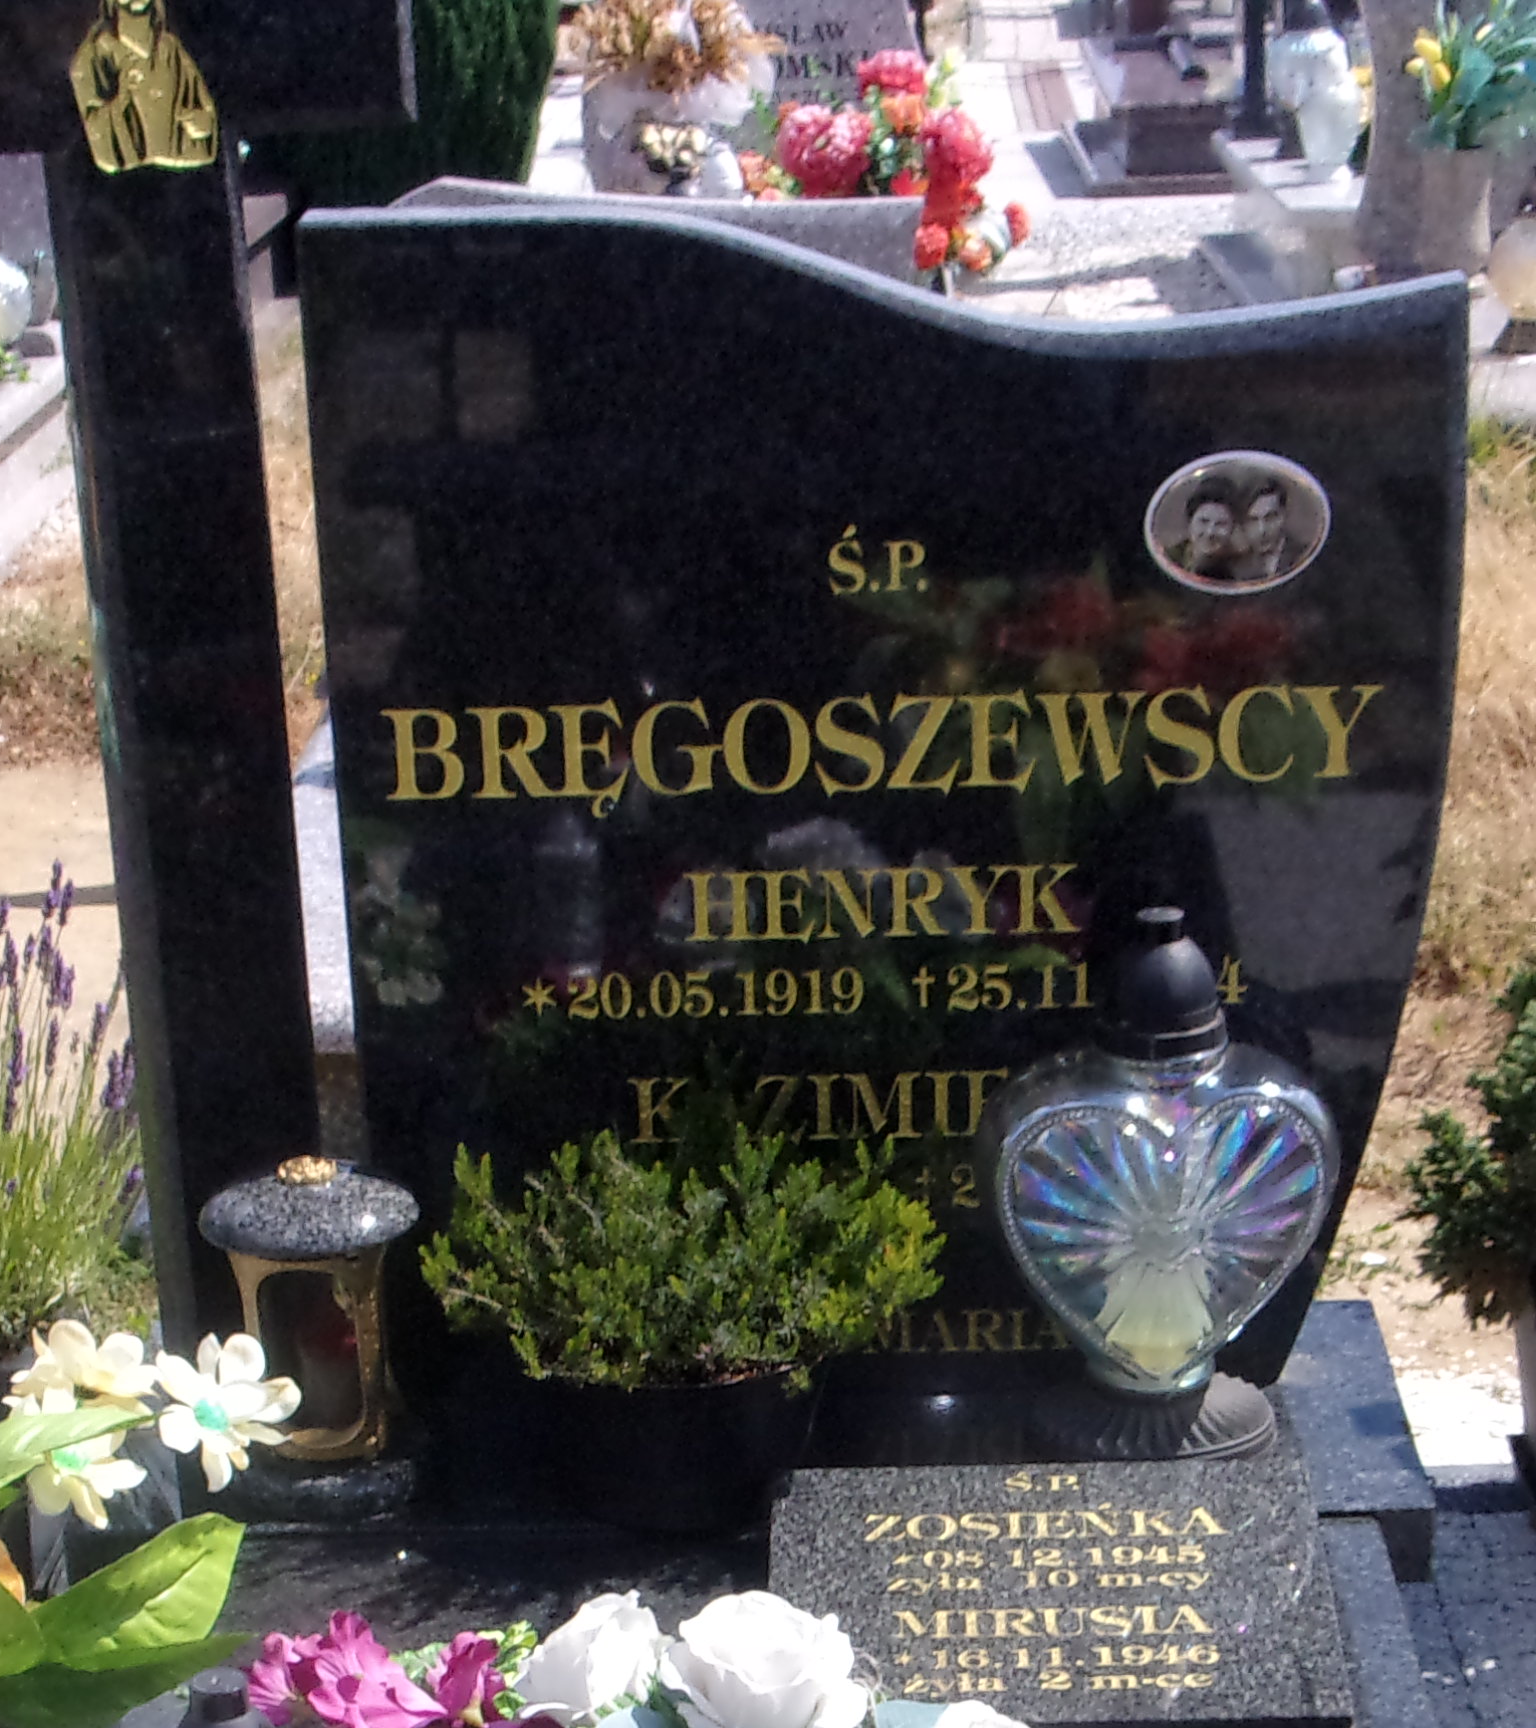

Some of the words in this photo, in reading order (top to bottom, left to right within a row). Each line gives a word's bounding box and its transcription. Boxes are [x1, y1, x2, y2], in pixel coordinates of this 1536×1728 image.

[828, 523, 928, 596] Ś.P.
[380, 684, 1384, 820] BRĘGOSZEWSCY
[684, 863, 1082, 943] HENRYK
[864, 1502, 1230, 1543] ZOSIEŃKA
[1023, 1569, 1079, 1589] 10
[892, 1604, 1214, 1639] MIRUSIA
[1039, 1670, 1074, 1691] 2
